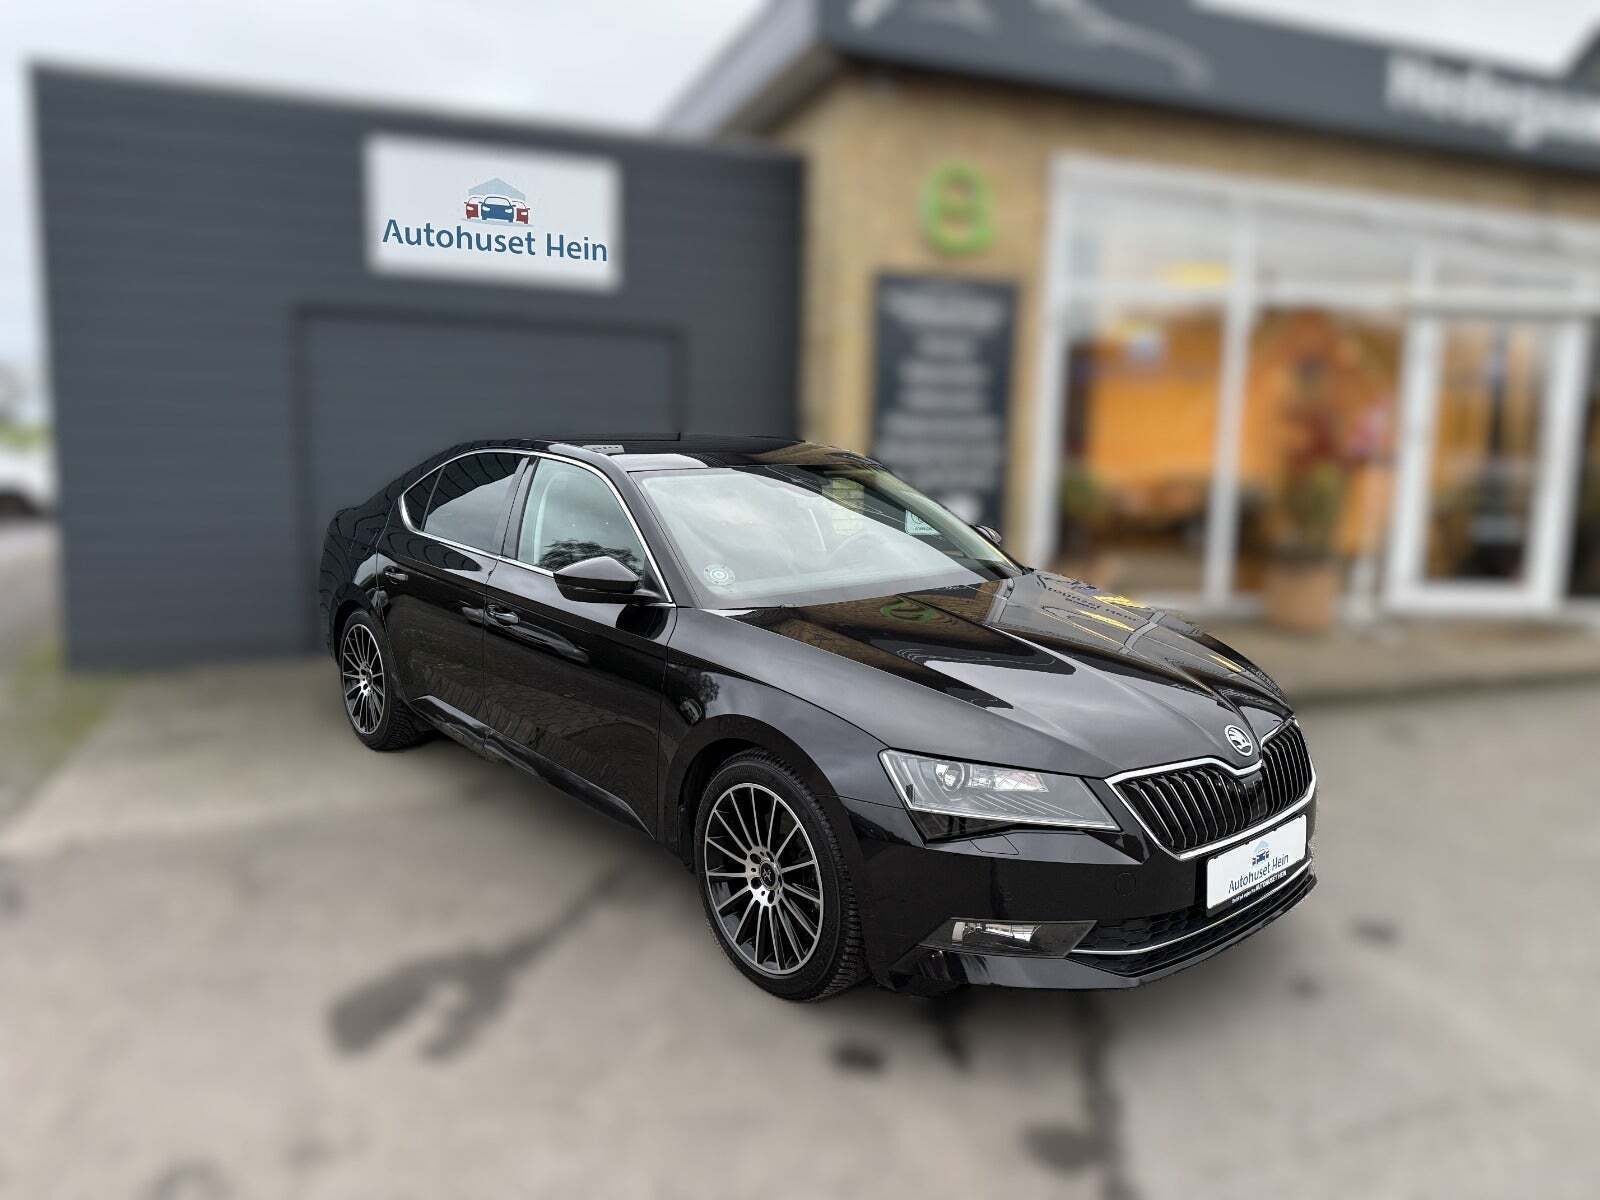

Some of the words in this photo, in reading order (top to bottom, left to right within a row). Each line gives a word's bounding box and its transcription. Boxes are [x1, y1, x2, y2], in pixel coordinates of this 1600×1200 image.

[382, 219, 536, 255] Autohuset
[546, 233, 608, 261] Hein
[1228, 864, 1270, 894] Autohuset
[1272, 854, 1289, 871] Hein
